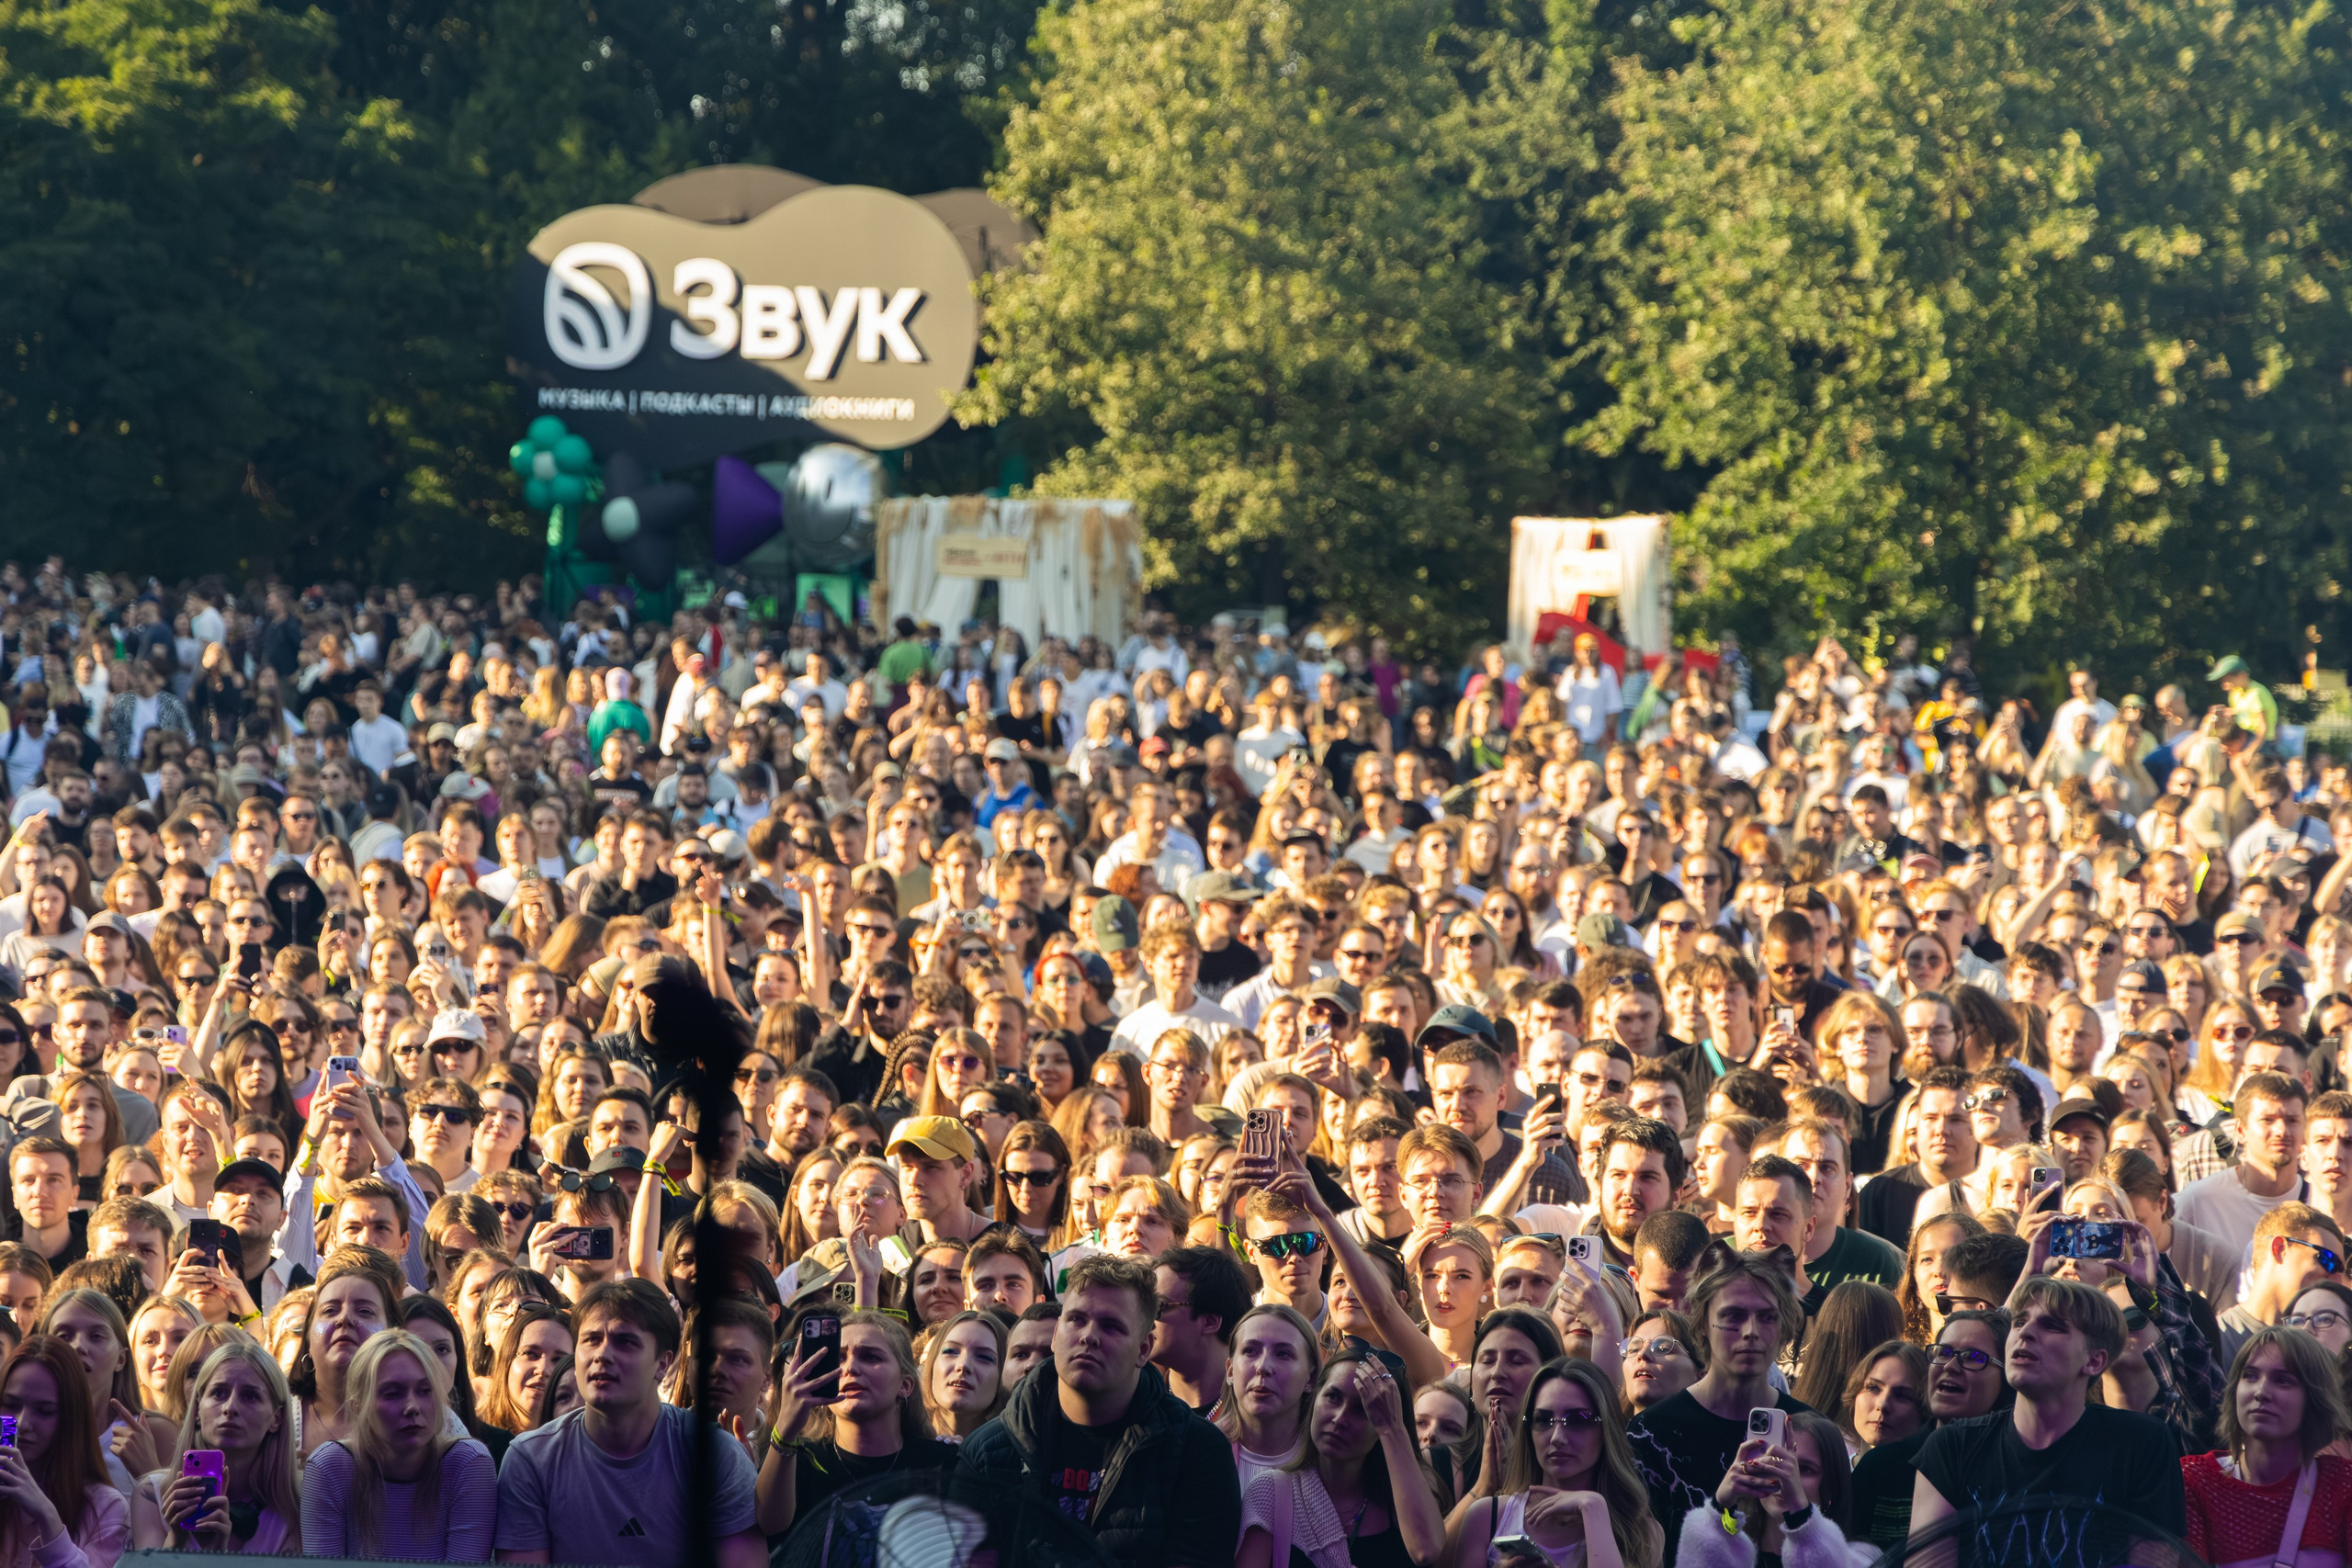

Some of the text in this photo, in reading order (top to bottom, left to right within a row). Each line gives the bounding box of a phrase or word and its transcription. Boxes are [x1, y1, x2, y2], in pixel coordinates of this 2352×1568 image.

[670, 256, 923, 381] Звук
[537, 386, 916, 421] МУЗЫКА ПОДКАСТЫ АУДИОКНИГИ
